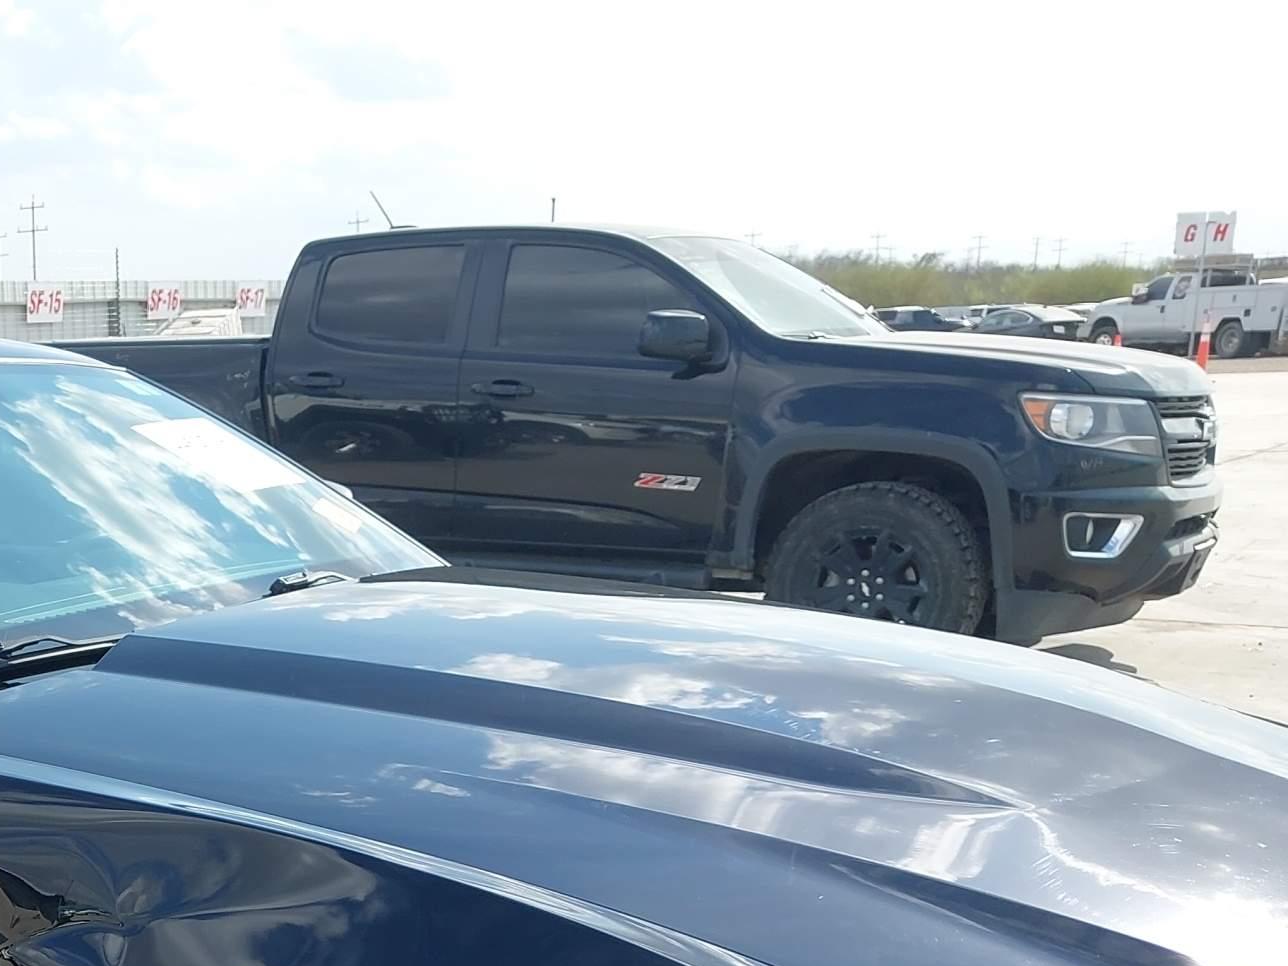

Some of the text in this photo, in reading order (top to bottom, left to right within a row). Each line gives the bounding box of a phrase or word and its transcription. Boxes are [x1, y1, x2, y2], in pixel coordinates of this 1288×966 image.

[1184, 224, 1229, 242] G H
[28, 290, 61, 315] SF-15
